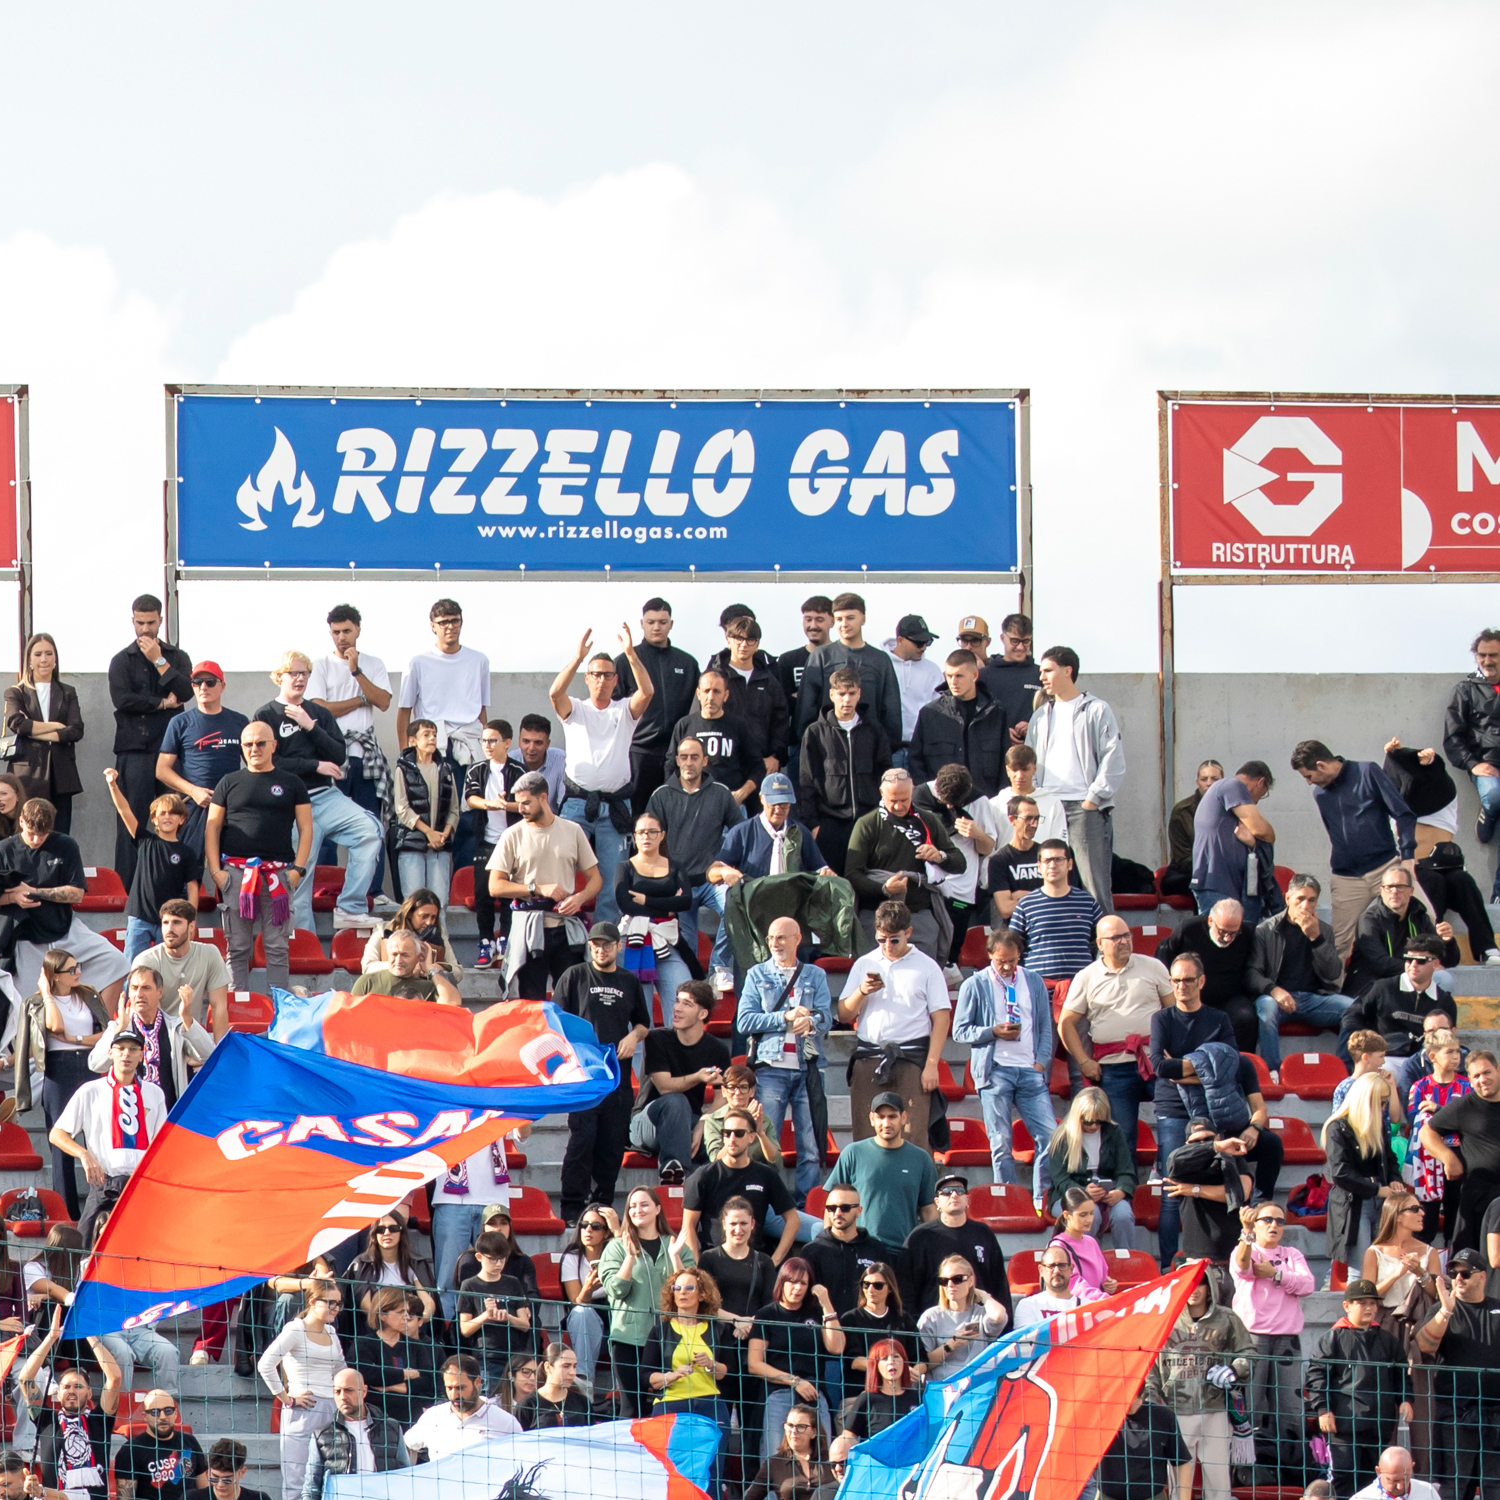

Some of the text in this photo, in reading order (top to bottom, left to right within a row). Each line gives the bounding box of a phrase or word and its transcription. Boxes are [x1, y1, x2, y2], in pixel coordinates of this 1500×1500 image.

[333, 428, 961, 518] RIZZELLO GAS
[477, 521, 729, 544] www.rizzellogas.com
[1212, 541, 1355, 567] RISTRUTTURA
[706, 738, 733, 758] ON
[590, 986, 624, 998] CONFIDENCE
[147, 1457, 177, 1473] CUSP
[150, 1469, 175, 1483] 1980
